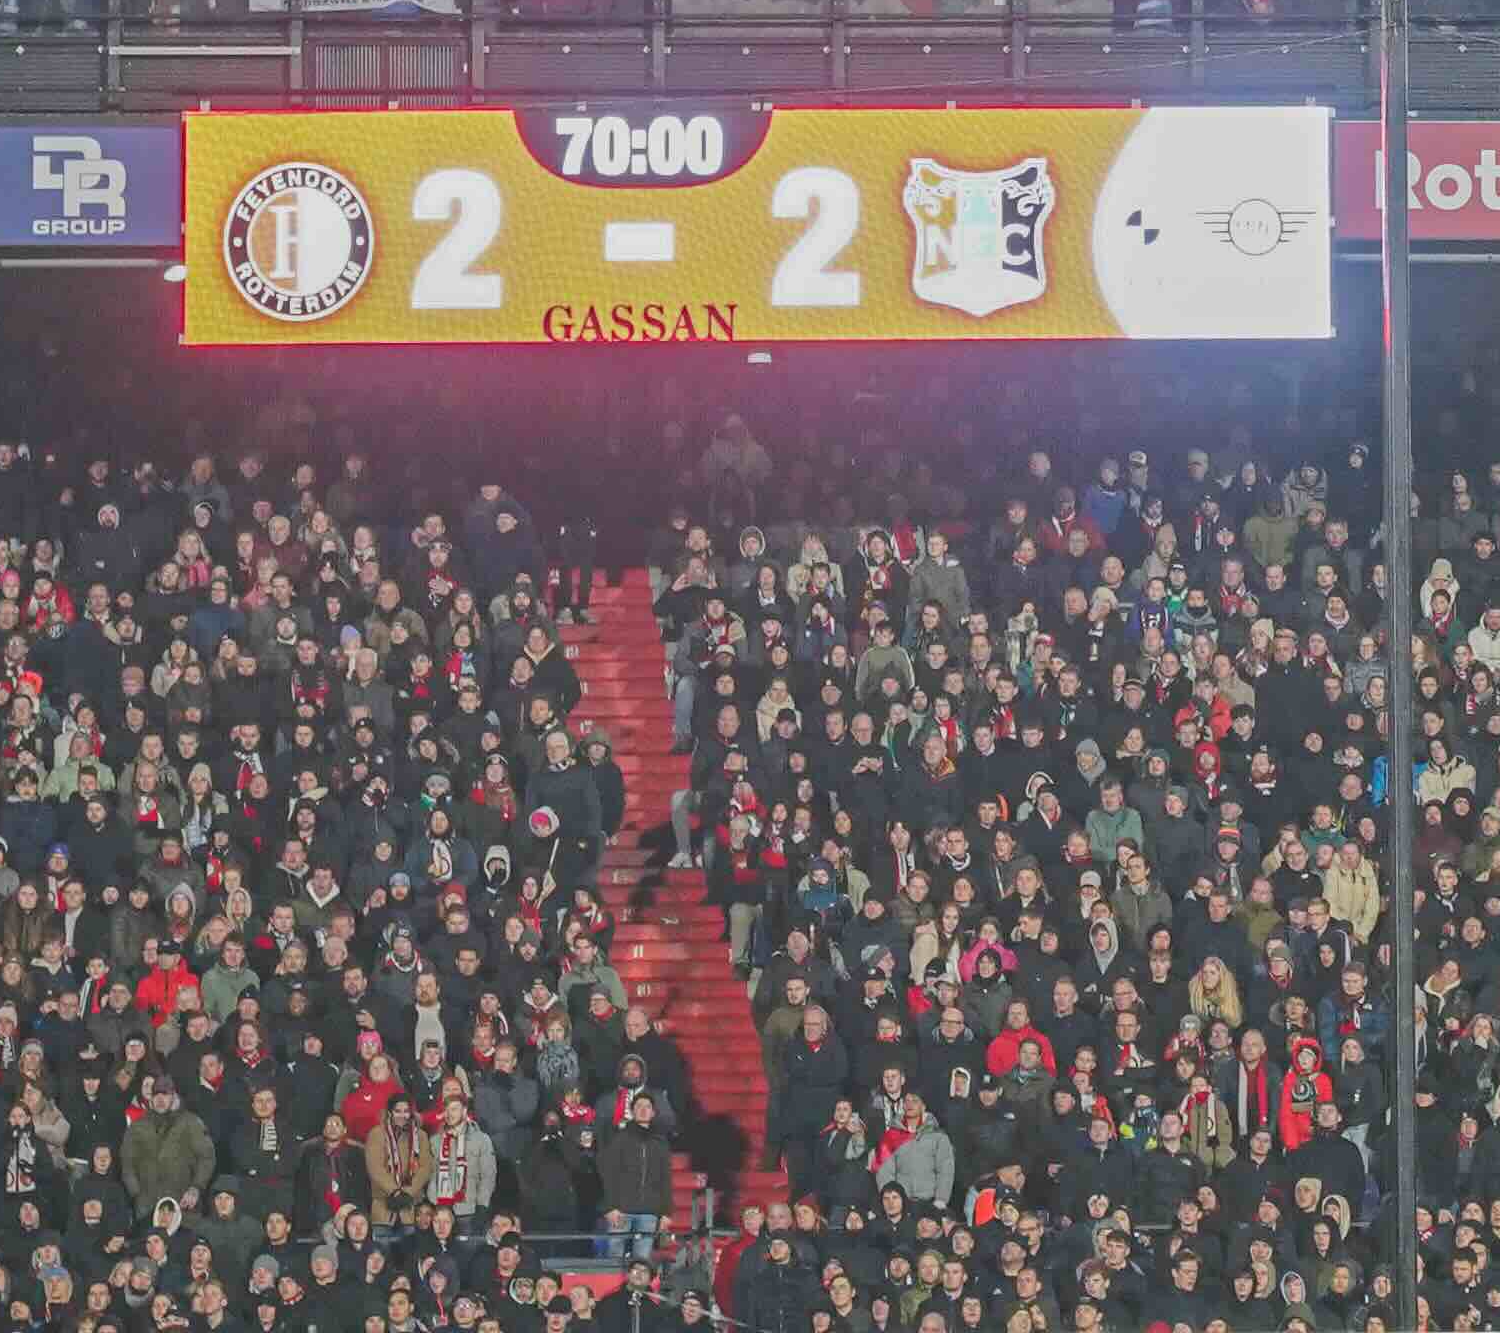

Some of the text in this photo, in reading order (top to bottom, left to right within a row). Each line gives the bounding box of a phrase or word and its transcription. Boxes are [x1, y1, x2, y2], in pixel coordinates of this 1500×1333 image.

[556, 116, 723, 176] 70:00
[236, 168, 362, 222] FEYENOORD
[32, 220, 125, 235] GROUP
[412, 168, 501, 309] 2
[772, 167, 861, 307] 2
[235, 260, 364, 315] ROTTERDAM
[542, 304, 739, 342] GASSAN
